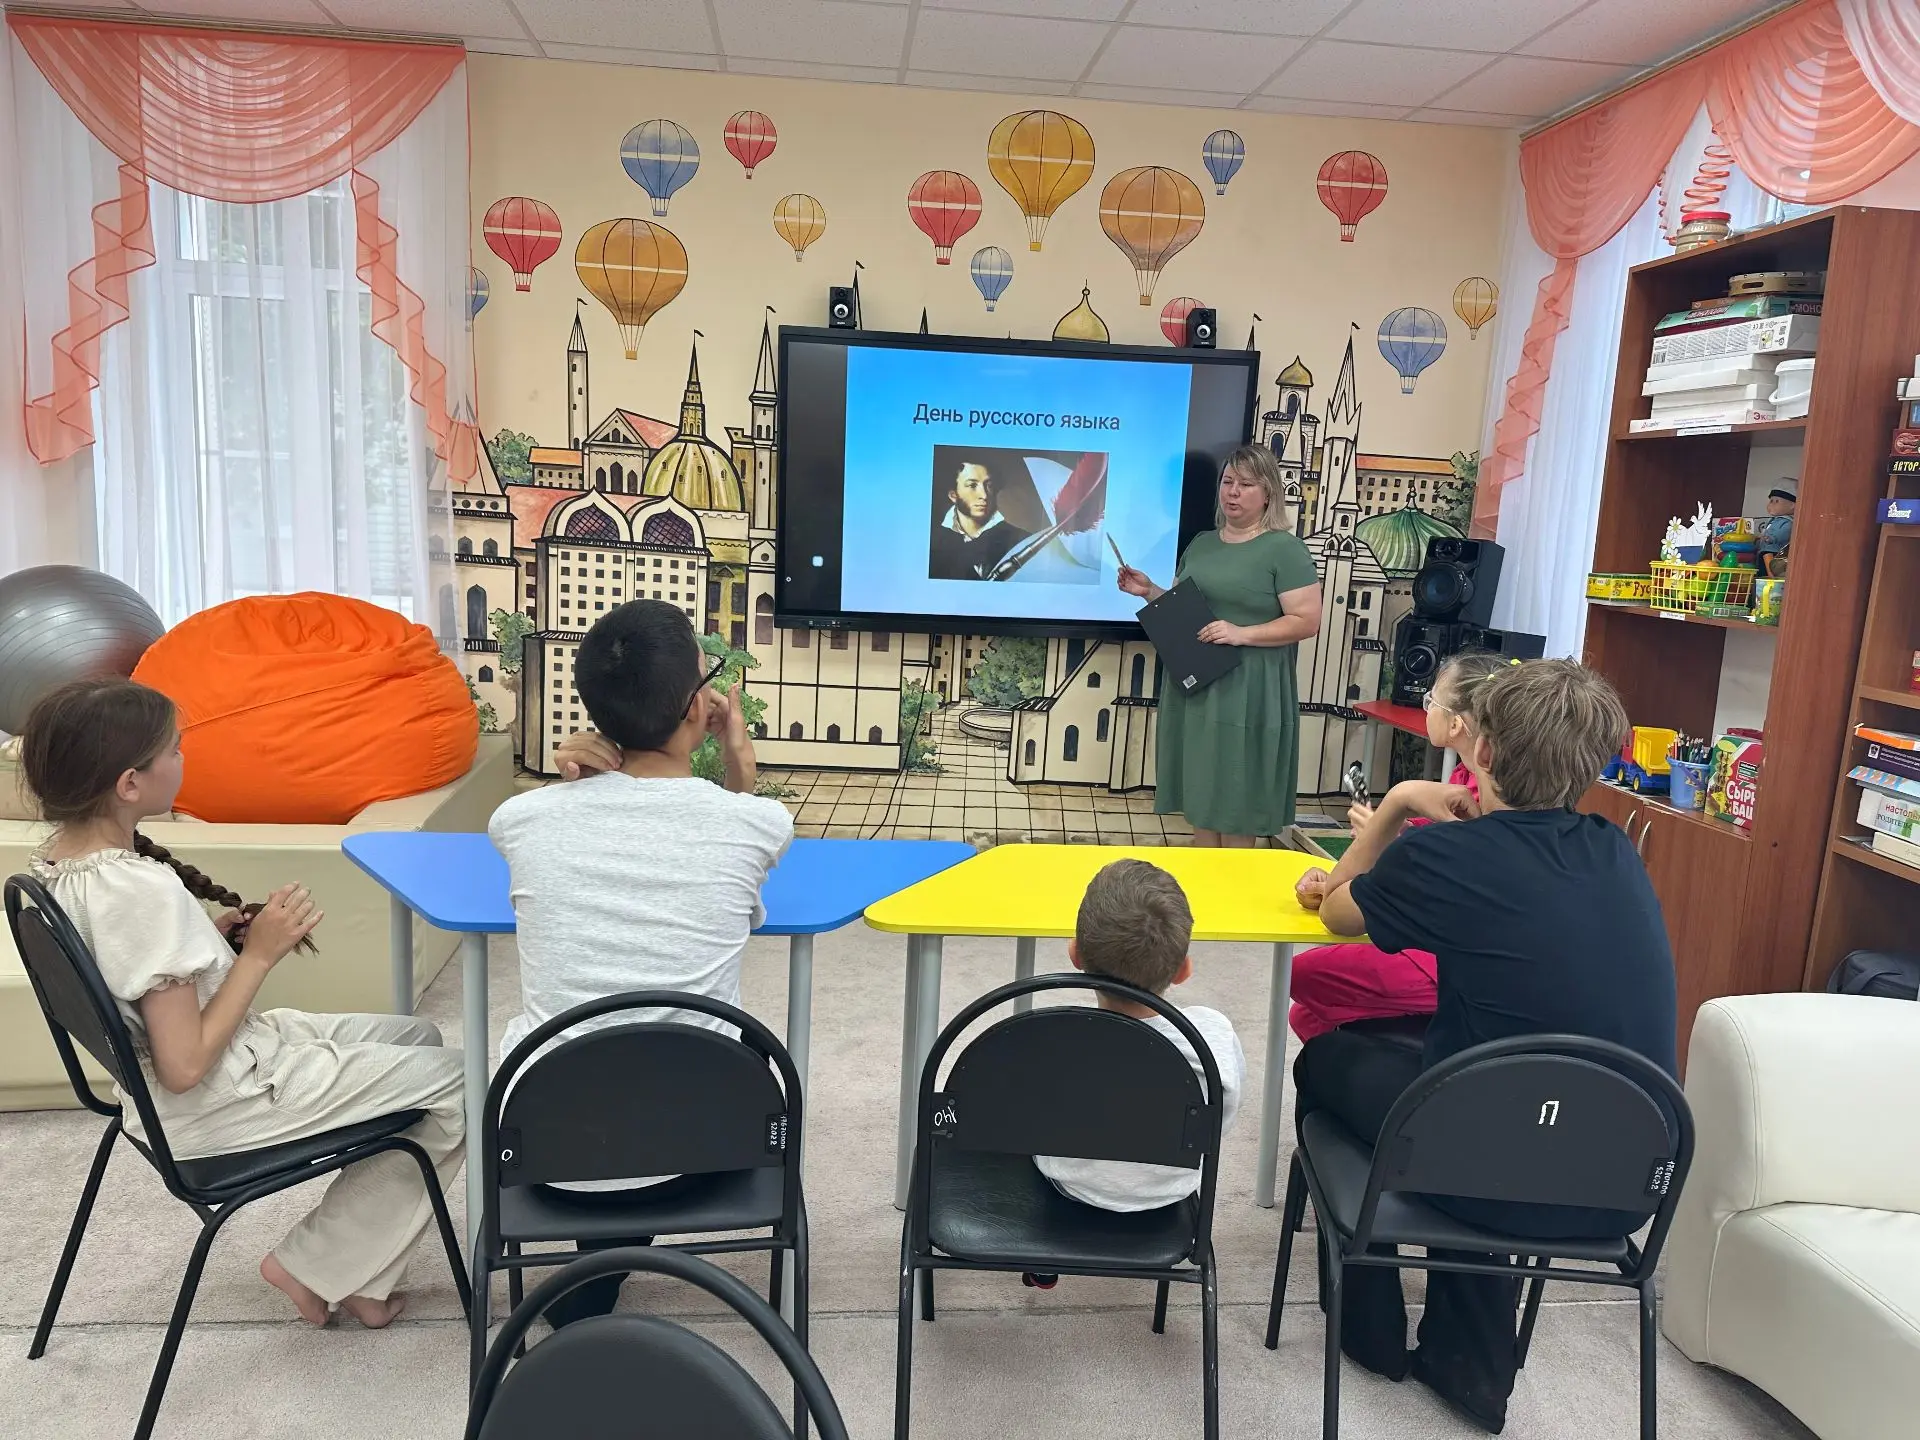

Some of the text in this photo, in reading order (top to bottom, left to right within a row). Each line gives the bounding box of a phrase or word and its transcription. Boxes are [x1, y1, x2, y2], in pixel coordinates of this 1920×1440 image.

[912, 403, 1121, 431] День русского языка
